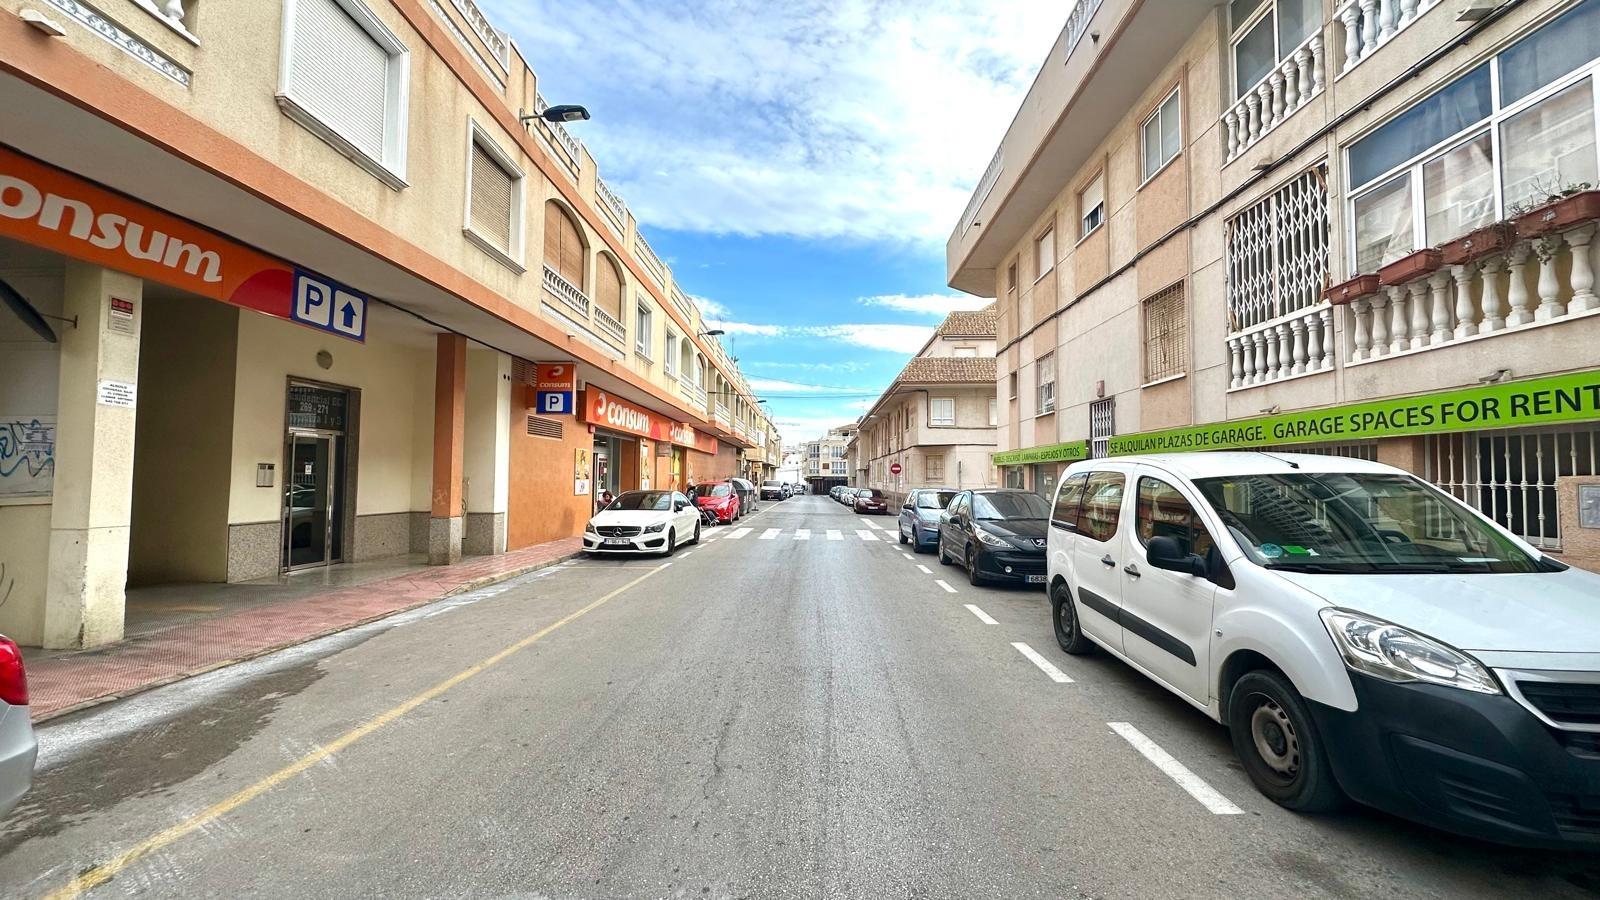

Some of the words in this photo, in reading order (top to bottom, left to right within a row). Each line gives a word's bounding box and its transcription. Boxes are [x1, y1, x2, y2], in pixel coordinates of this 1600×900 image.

[305, 284, 323, 315] P
[549, 395, 559, 410] P
[607, 402, 649, 433] consum
[1110, 441, 1118, 454] SE
[1119, 438, 1156, 452] ALQUILAN
[1157, 433, 1193, 449] PLAZAS
[1195, 432, 1209, 446] DE
[1211, 426, 1266, 444] GARAGE.
[1273, 416, 1344, 439] GARAGE
[1349, 405, 1435, 432] SPACES
[1441, 397, 1500, 424] FOR
[1510, 384, 1600, 418] RENT
[1063, 446, 1080, 457] OTROS
